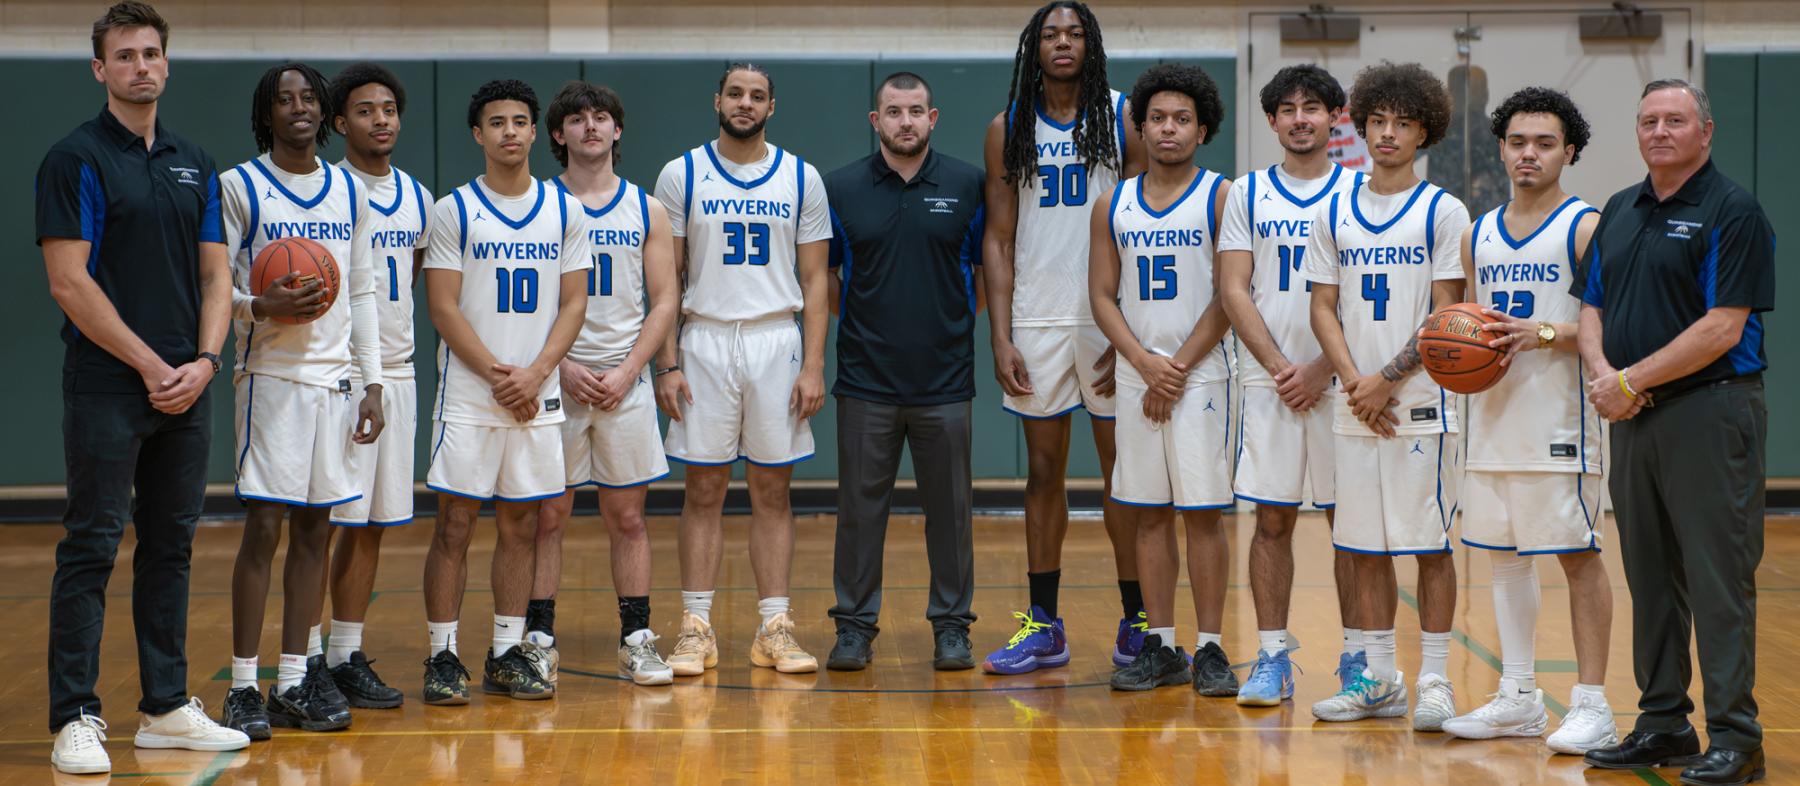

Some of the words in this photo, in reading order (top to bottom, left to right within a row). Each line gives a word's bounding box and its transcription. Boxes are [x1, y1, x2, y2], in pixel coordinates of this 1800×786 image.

[1037, 163, 1088, 208] 30
[702, 199, 791, 219] WYVERNS
[262, 222, 351, 241] WYVERNS
[371, 230, 421, 249] YVERNS
[588, 229, 641, 248] ERNS
[1118, 229, 1203, 248] WYVERNS
[1256, 219, 1314, 239] WYVE
[472, 242, 559, 261] WYVERNS
[722, 221, 770, 266] 33
[1338, 245, 1425, 268] WYVERNS
[386, 255, 399, 302] 1
[1136, 254, 1178, 301] 15
[1478, 263, 1560, 285] WYVERNS
[495, 267, 539, 314] 10
[1361, 273, 1390, 321] 4
